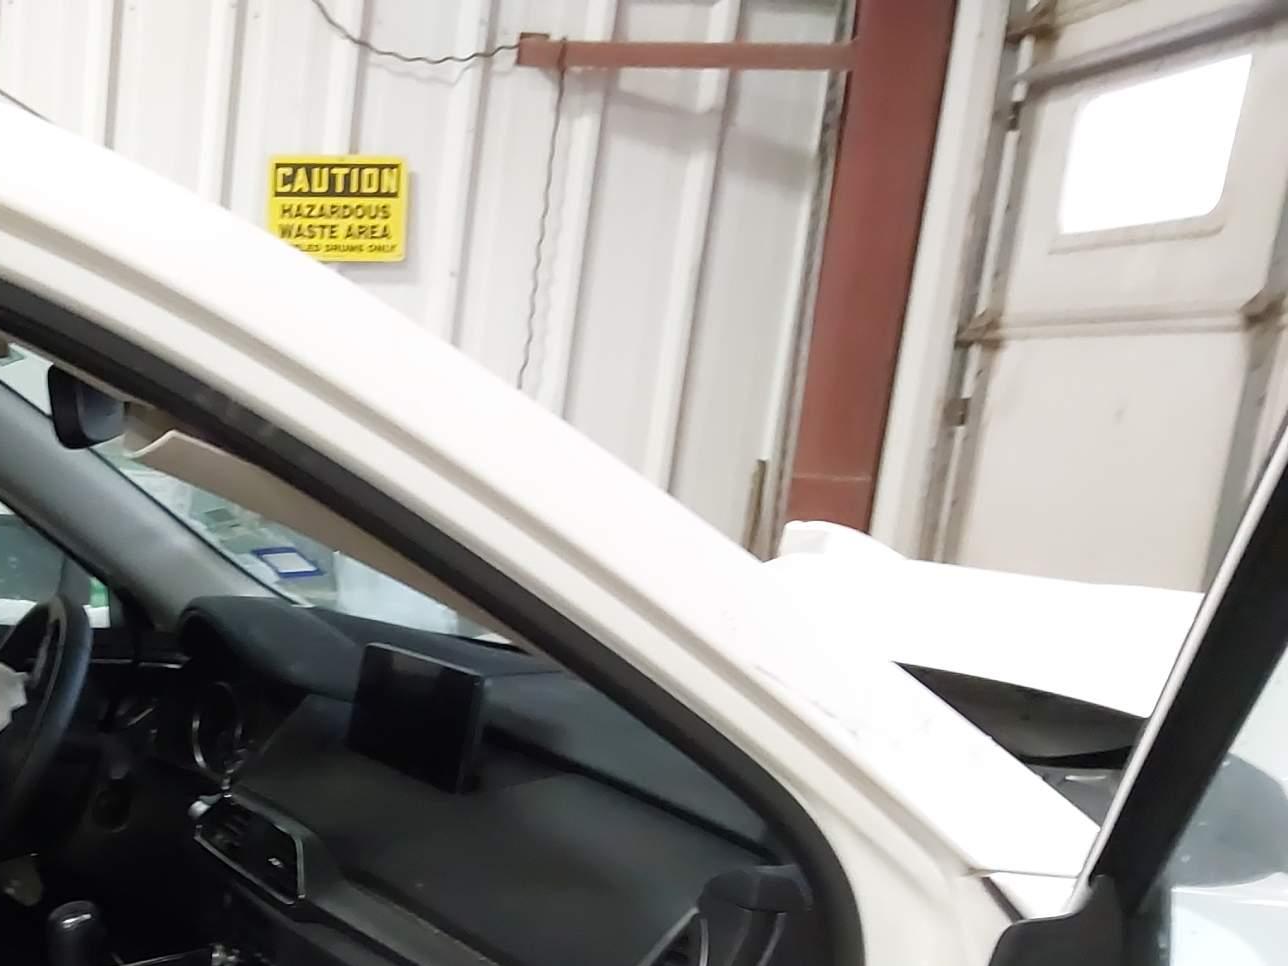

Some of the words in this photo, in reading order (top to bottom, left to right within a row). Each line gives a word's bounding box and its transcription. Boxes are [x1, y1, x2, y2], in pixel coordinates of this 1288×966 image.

[276, 166, 398, 193] CAUTION
[281, 203, 392, 219] HAZARDOUS
[279, 224, 338, 239] WASTE
[345, 224, 393, 239] AREA
[324, 243, 365, 253] DRUMS
[368, 243, 398, 253] ONLY
